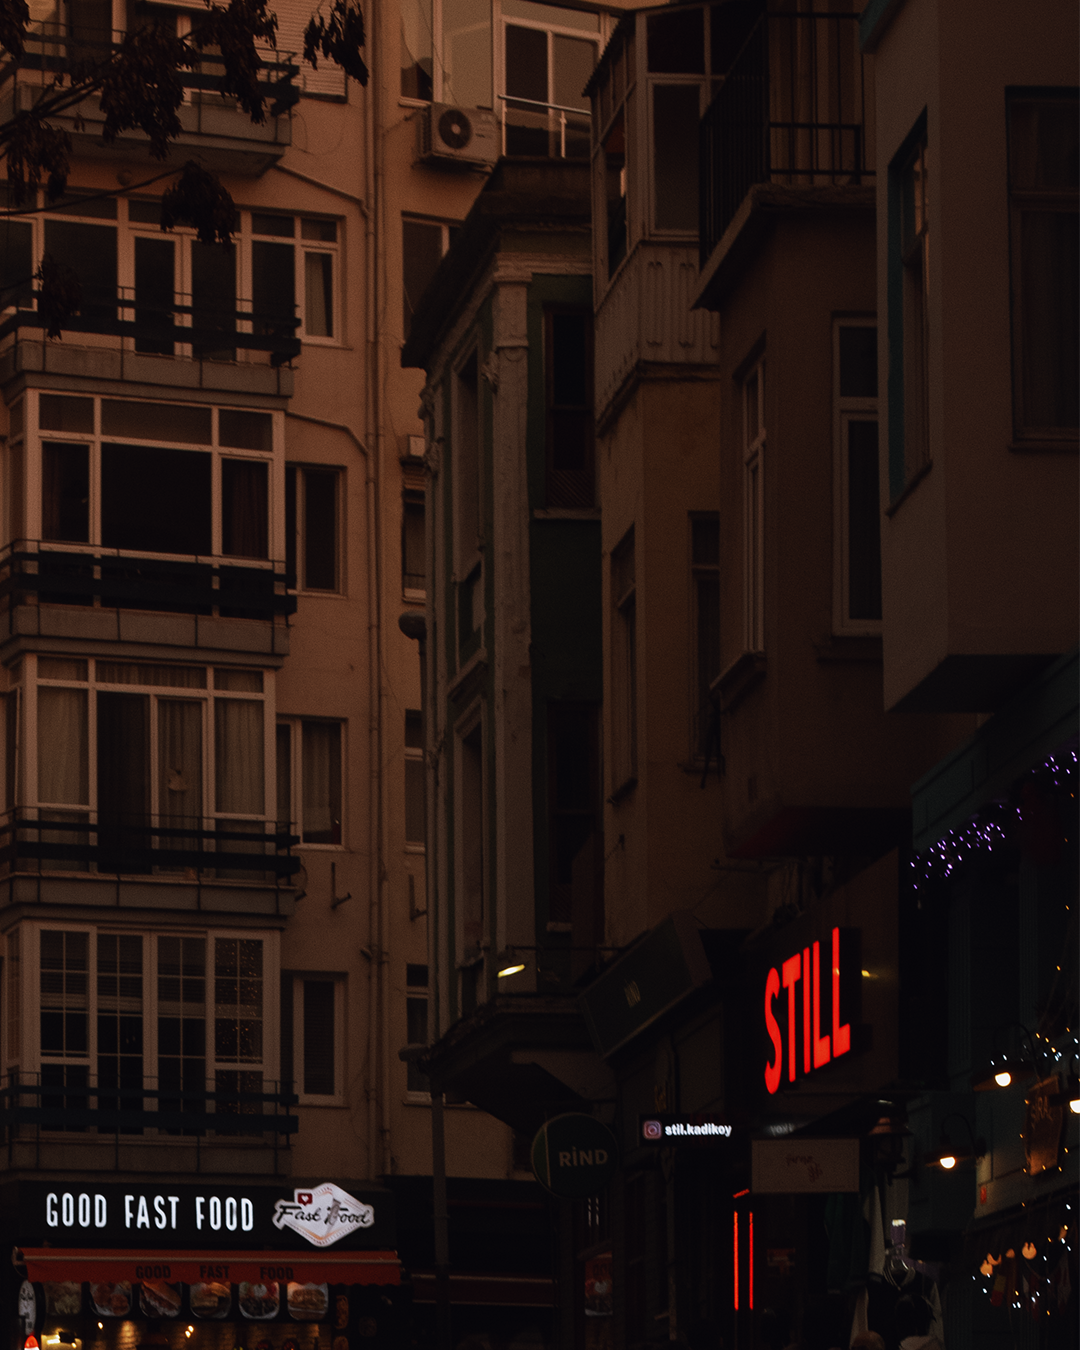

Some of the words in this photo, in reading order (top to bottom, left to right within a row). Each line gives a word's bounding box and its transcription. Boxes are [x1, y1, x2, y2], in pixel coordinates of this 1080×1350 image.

[764, 926, 851, 1095] STILL
[558, 1145, 609, 1168] RİND
[45, 1192, 108, 1229] GOOD
[124, 1194, 180, 1230] FAST
[195, 1196, 255, 1232] FOOD
[276, 1204, 322, 1223] Fast
[135, 1265, 172, 1279] GOOD
[199, 1265, 230, 1279] FAST
[259, 1266, 294, 1280] FOOD
